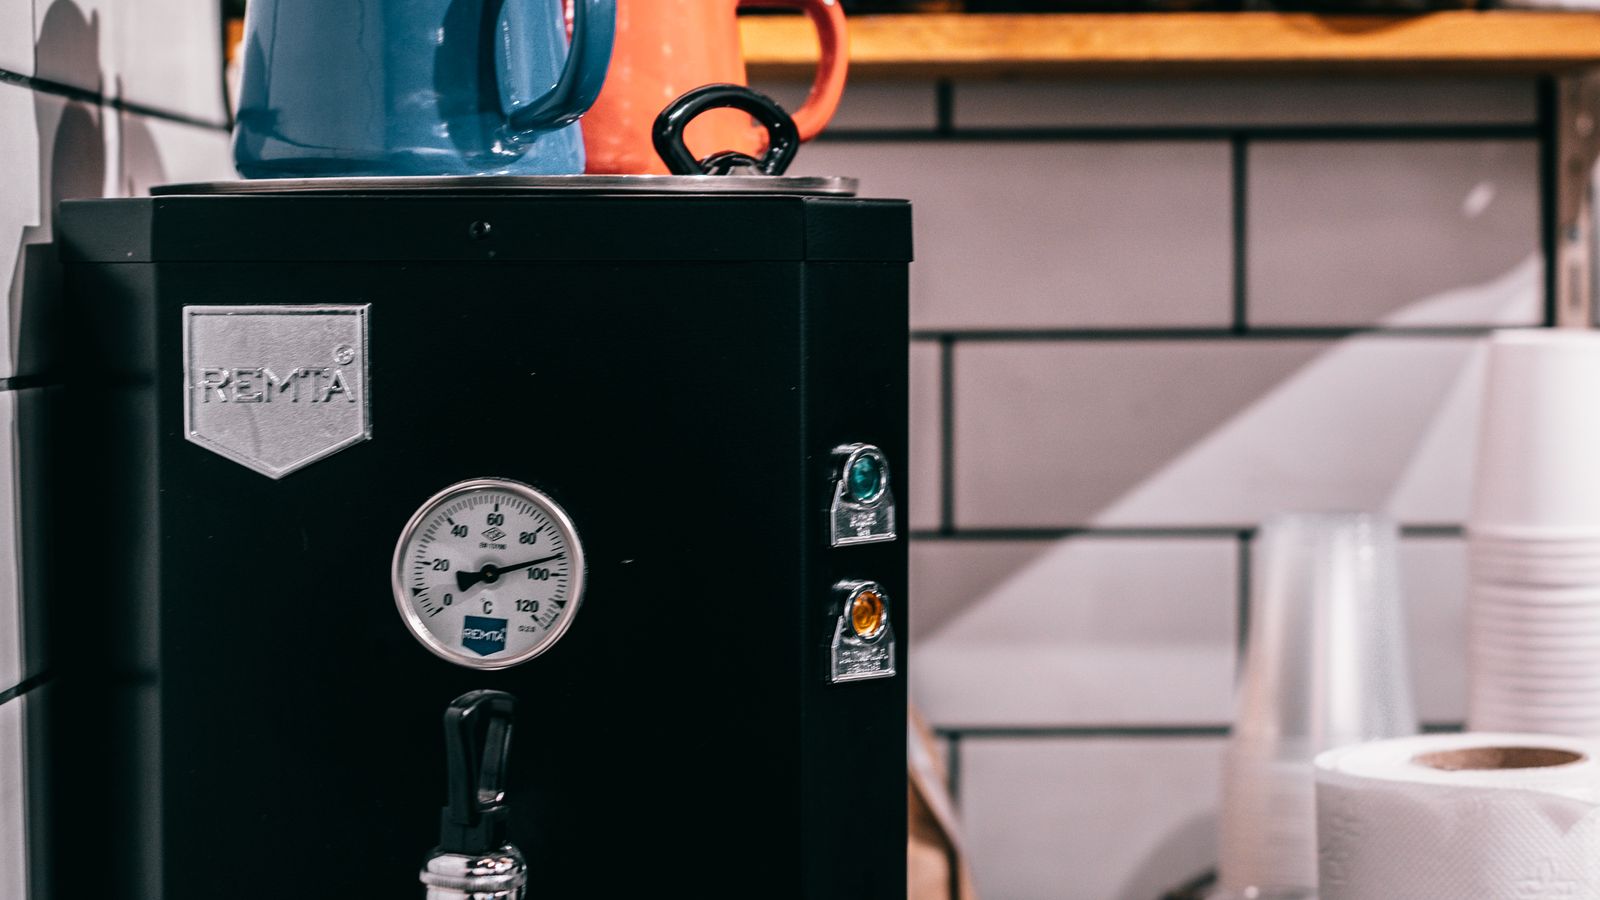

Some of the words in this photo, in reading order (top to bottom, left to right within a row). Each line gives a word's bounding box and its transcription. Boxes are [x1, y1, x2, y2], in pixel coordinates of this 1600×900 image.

[199, 366, 356, 403] REMTA
[487, 513, 504, 526] 60
[451, 525, 468, 538] 40
[519, 532, 537, 545] 80
[432, 559, 449, 571] 20
[527, 567, 549, 581] 100
[443, 593, 453, 606] 0
[515, 599, 539, 613] 120
